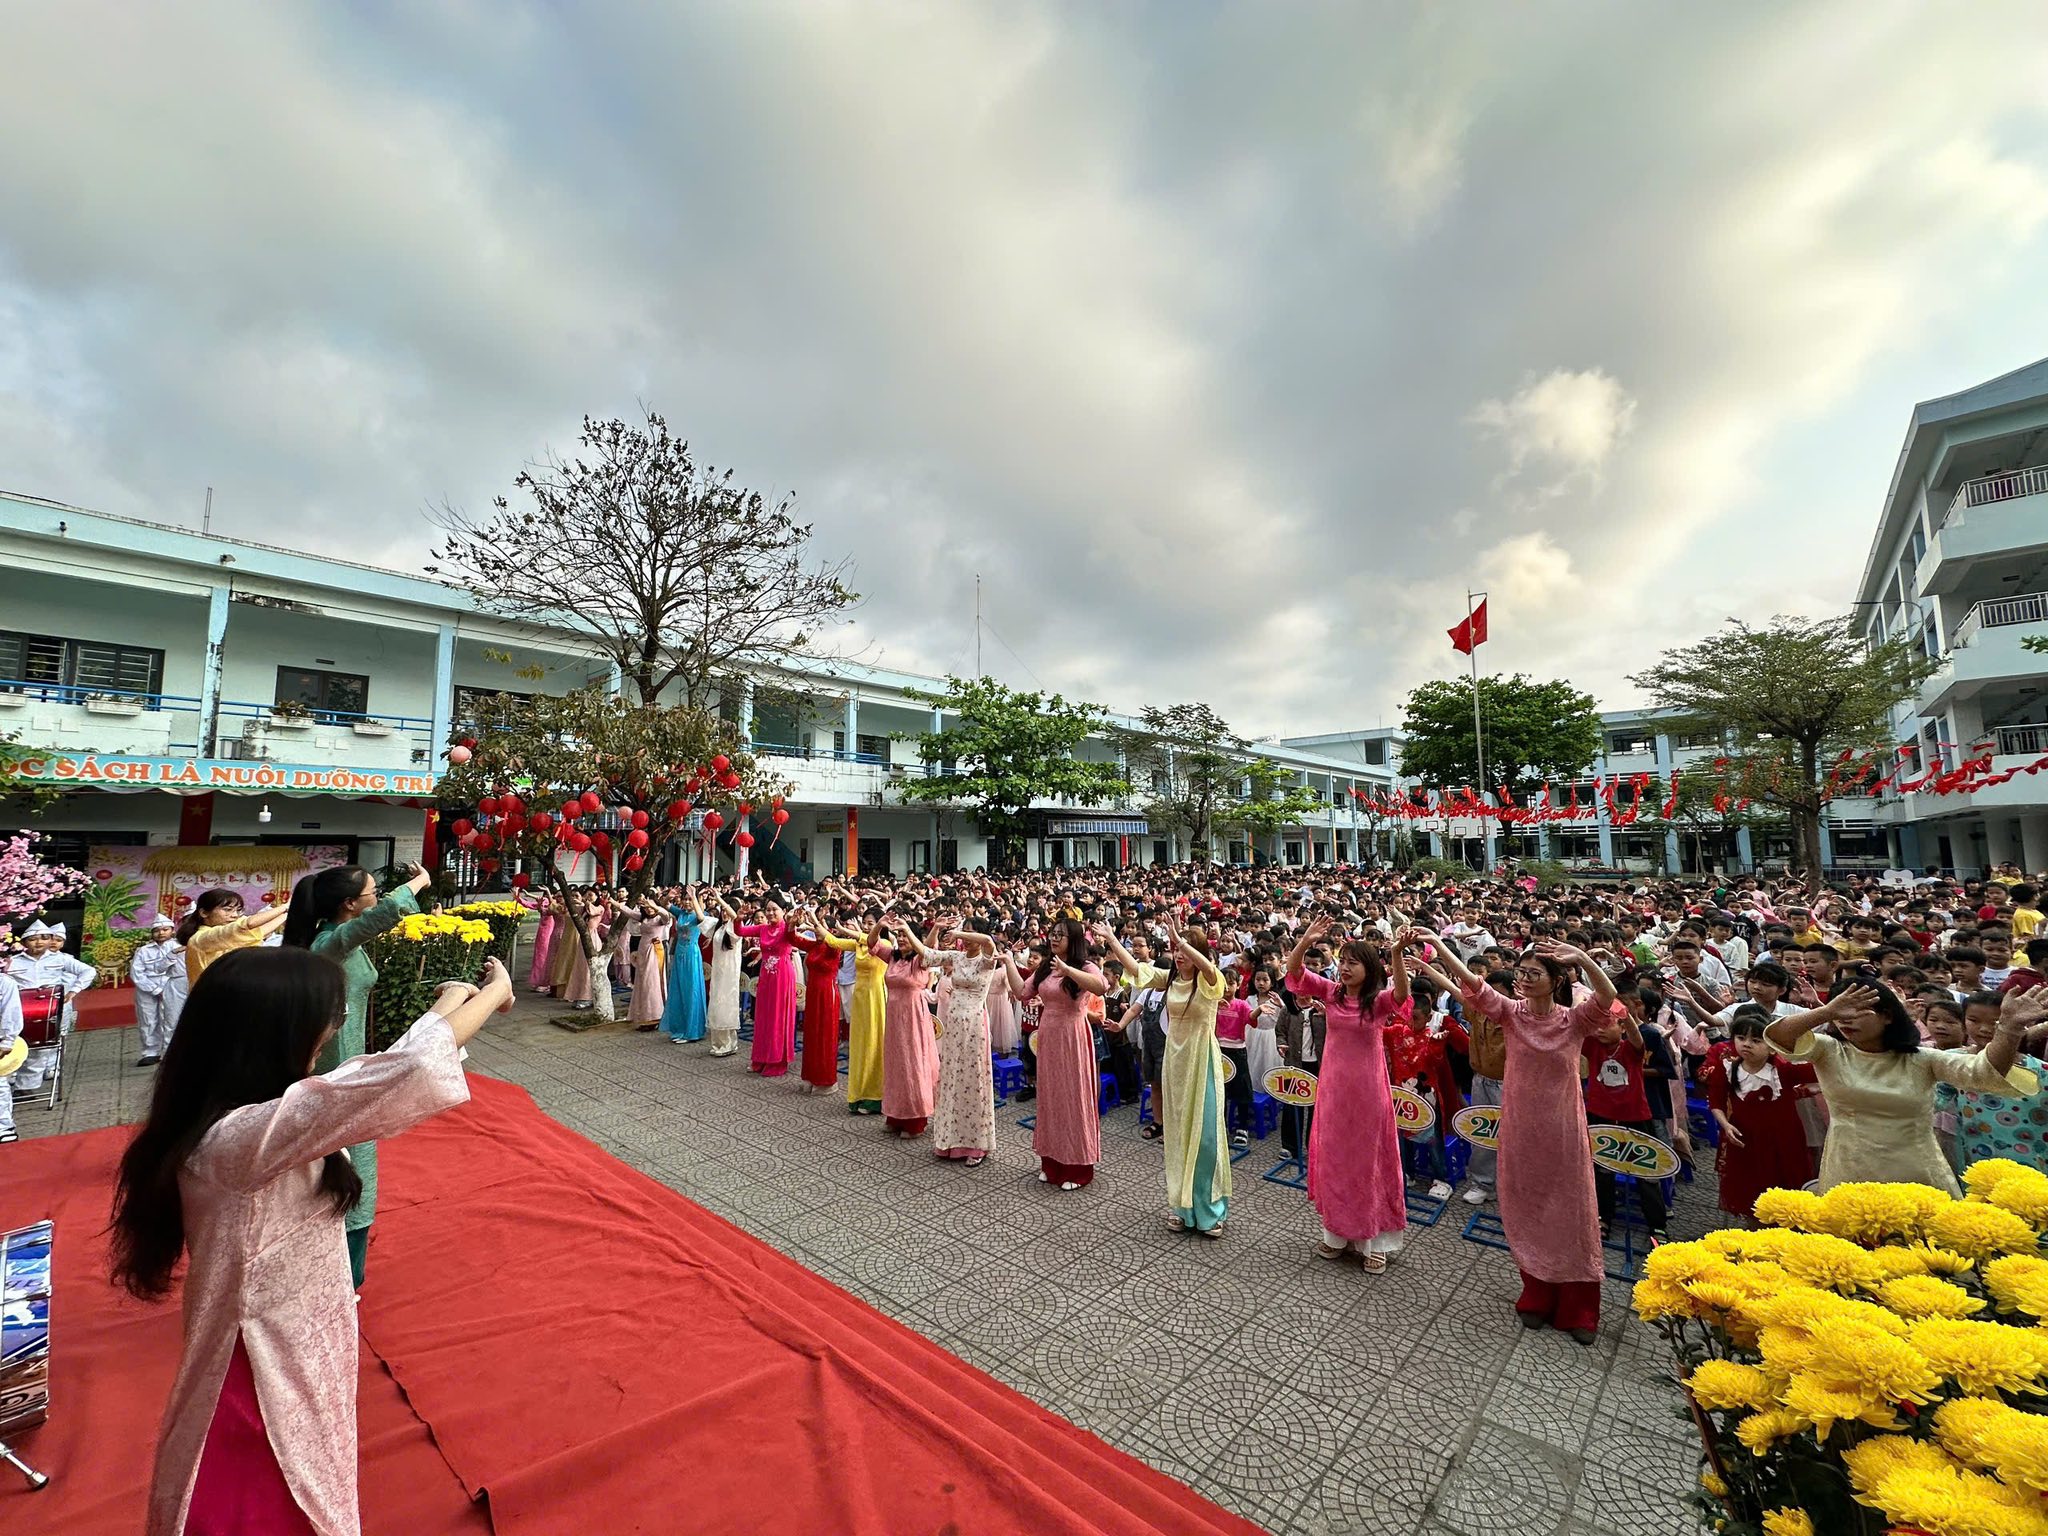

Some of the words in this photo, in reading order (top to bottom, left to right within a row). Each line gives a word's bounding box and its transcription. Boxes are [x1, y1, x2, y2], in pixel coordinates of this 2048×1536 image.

[55, 756, 150, 779] SÁCH
[160, 761, 200, 781] LÀ
[211, 765, 286, 784] NUÔI
[293, 769, 386, 789] DƯỠNG
[394, 774, 434, 791] TRÍ
[1275, 1075, 1312, 1098] 1/8
[1394, 1098, 1419, 1121] /9
[1471, 1116, 1500, 1138] 2/
[1595, 1135, 1657, 1170] 2/2
